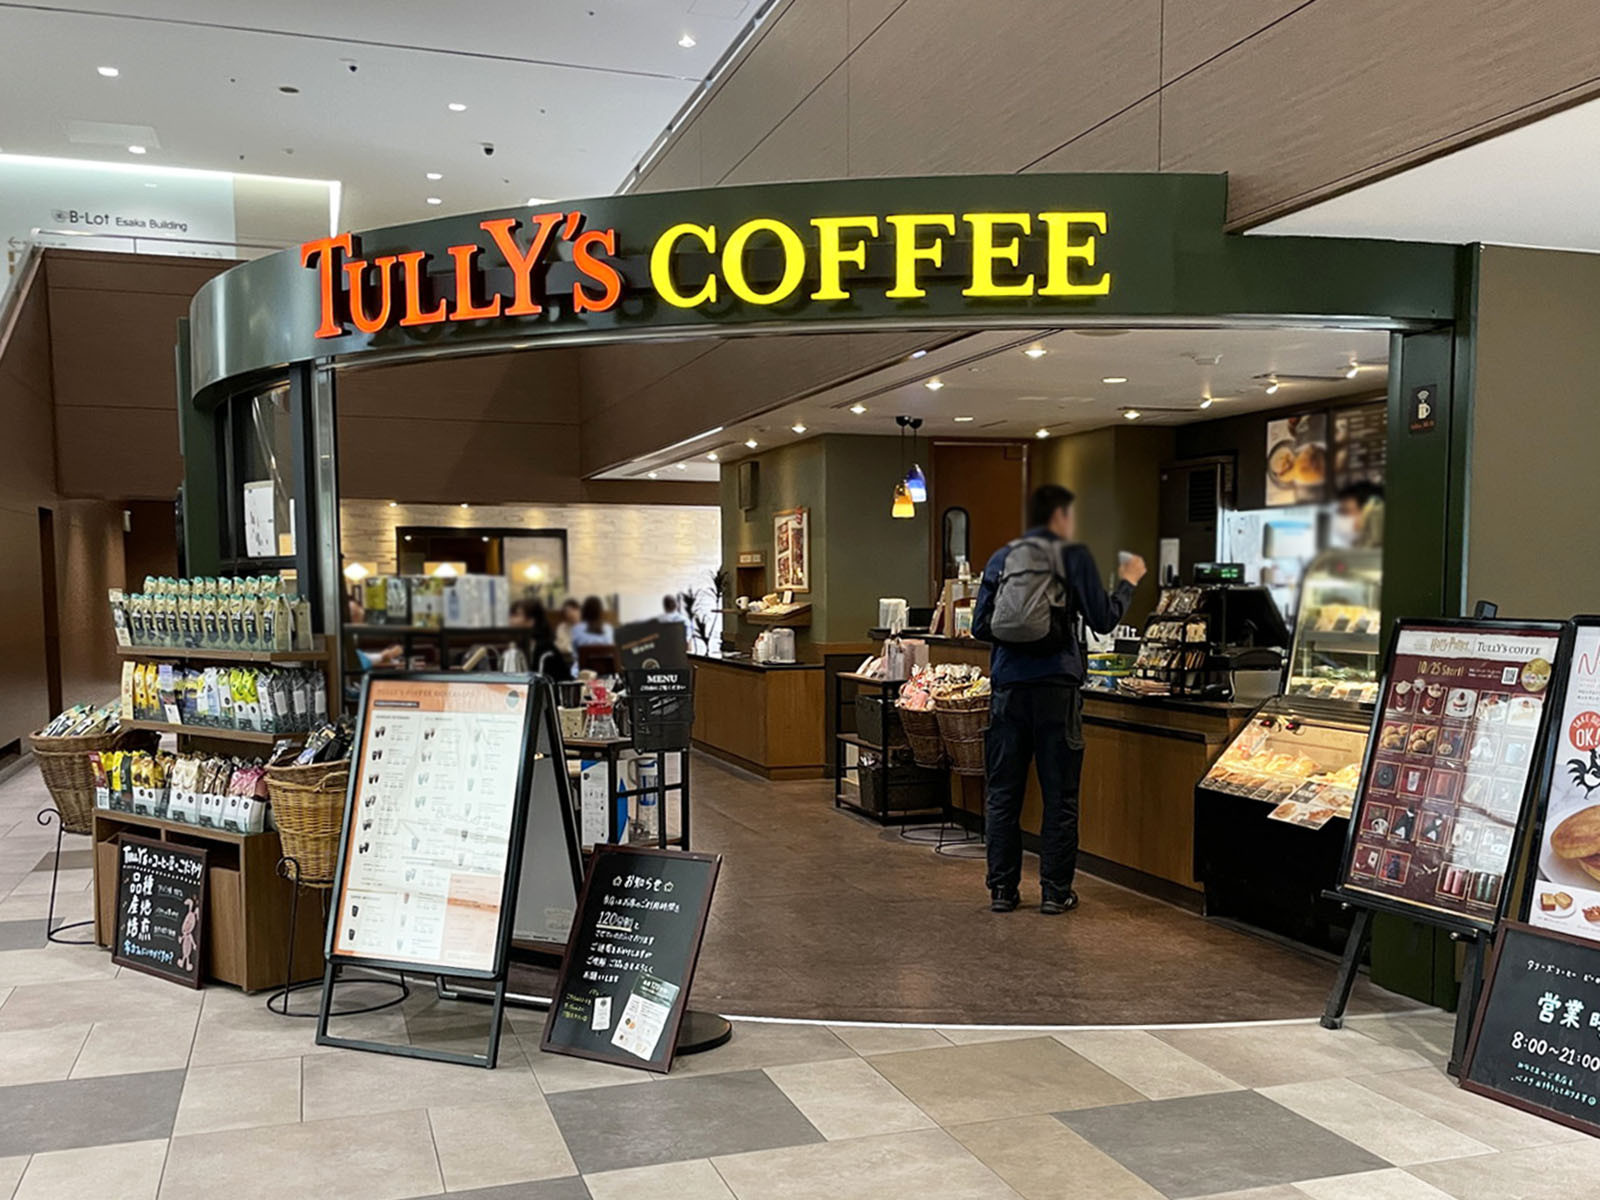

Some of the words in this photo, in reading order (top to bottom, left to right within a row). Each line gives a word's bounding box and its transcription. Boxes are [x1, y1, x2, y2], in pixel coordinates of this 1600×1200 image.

[69, 210, 109, 226] B-Lot
[115, 217, 147, 228] Esaka
[149, 219, 188, 233] Building
[301, 211, 621, 339] TULLY'S
[650, 210, 1111, 308] COFFEE
[1477, 641, 1507, 654] TULLY'S
[1508, 645, 1542, 655] COFFEE
[1417, 660, 1441, 676] 10/25
[646, 674, 678, 683] MENU
[1575, 727, 1600, 747] OK!
[129, 872, 154, 896] 品種
[624, 875, 661, 892] お知らせ
[127, 895, 152, 915] 産地
